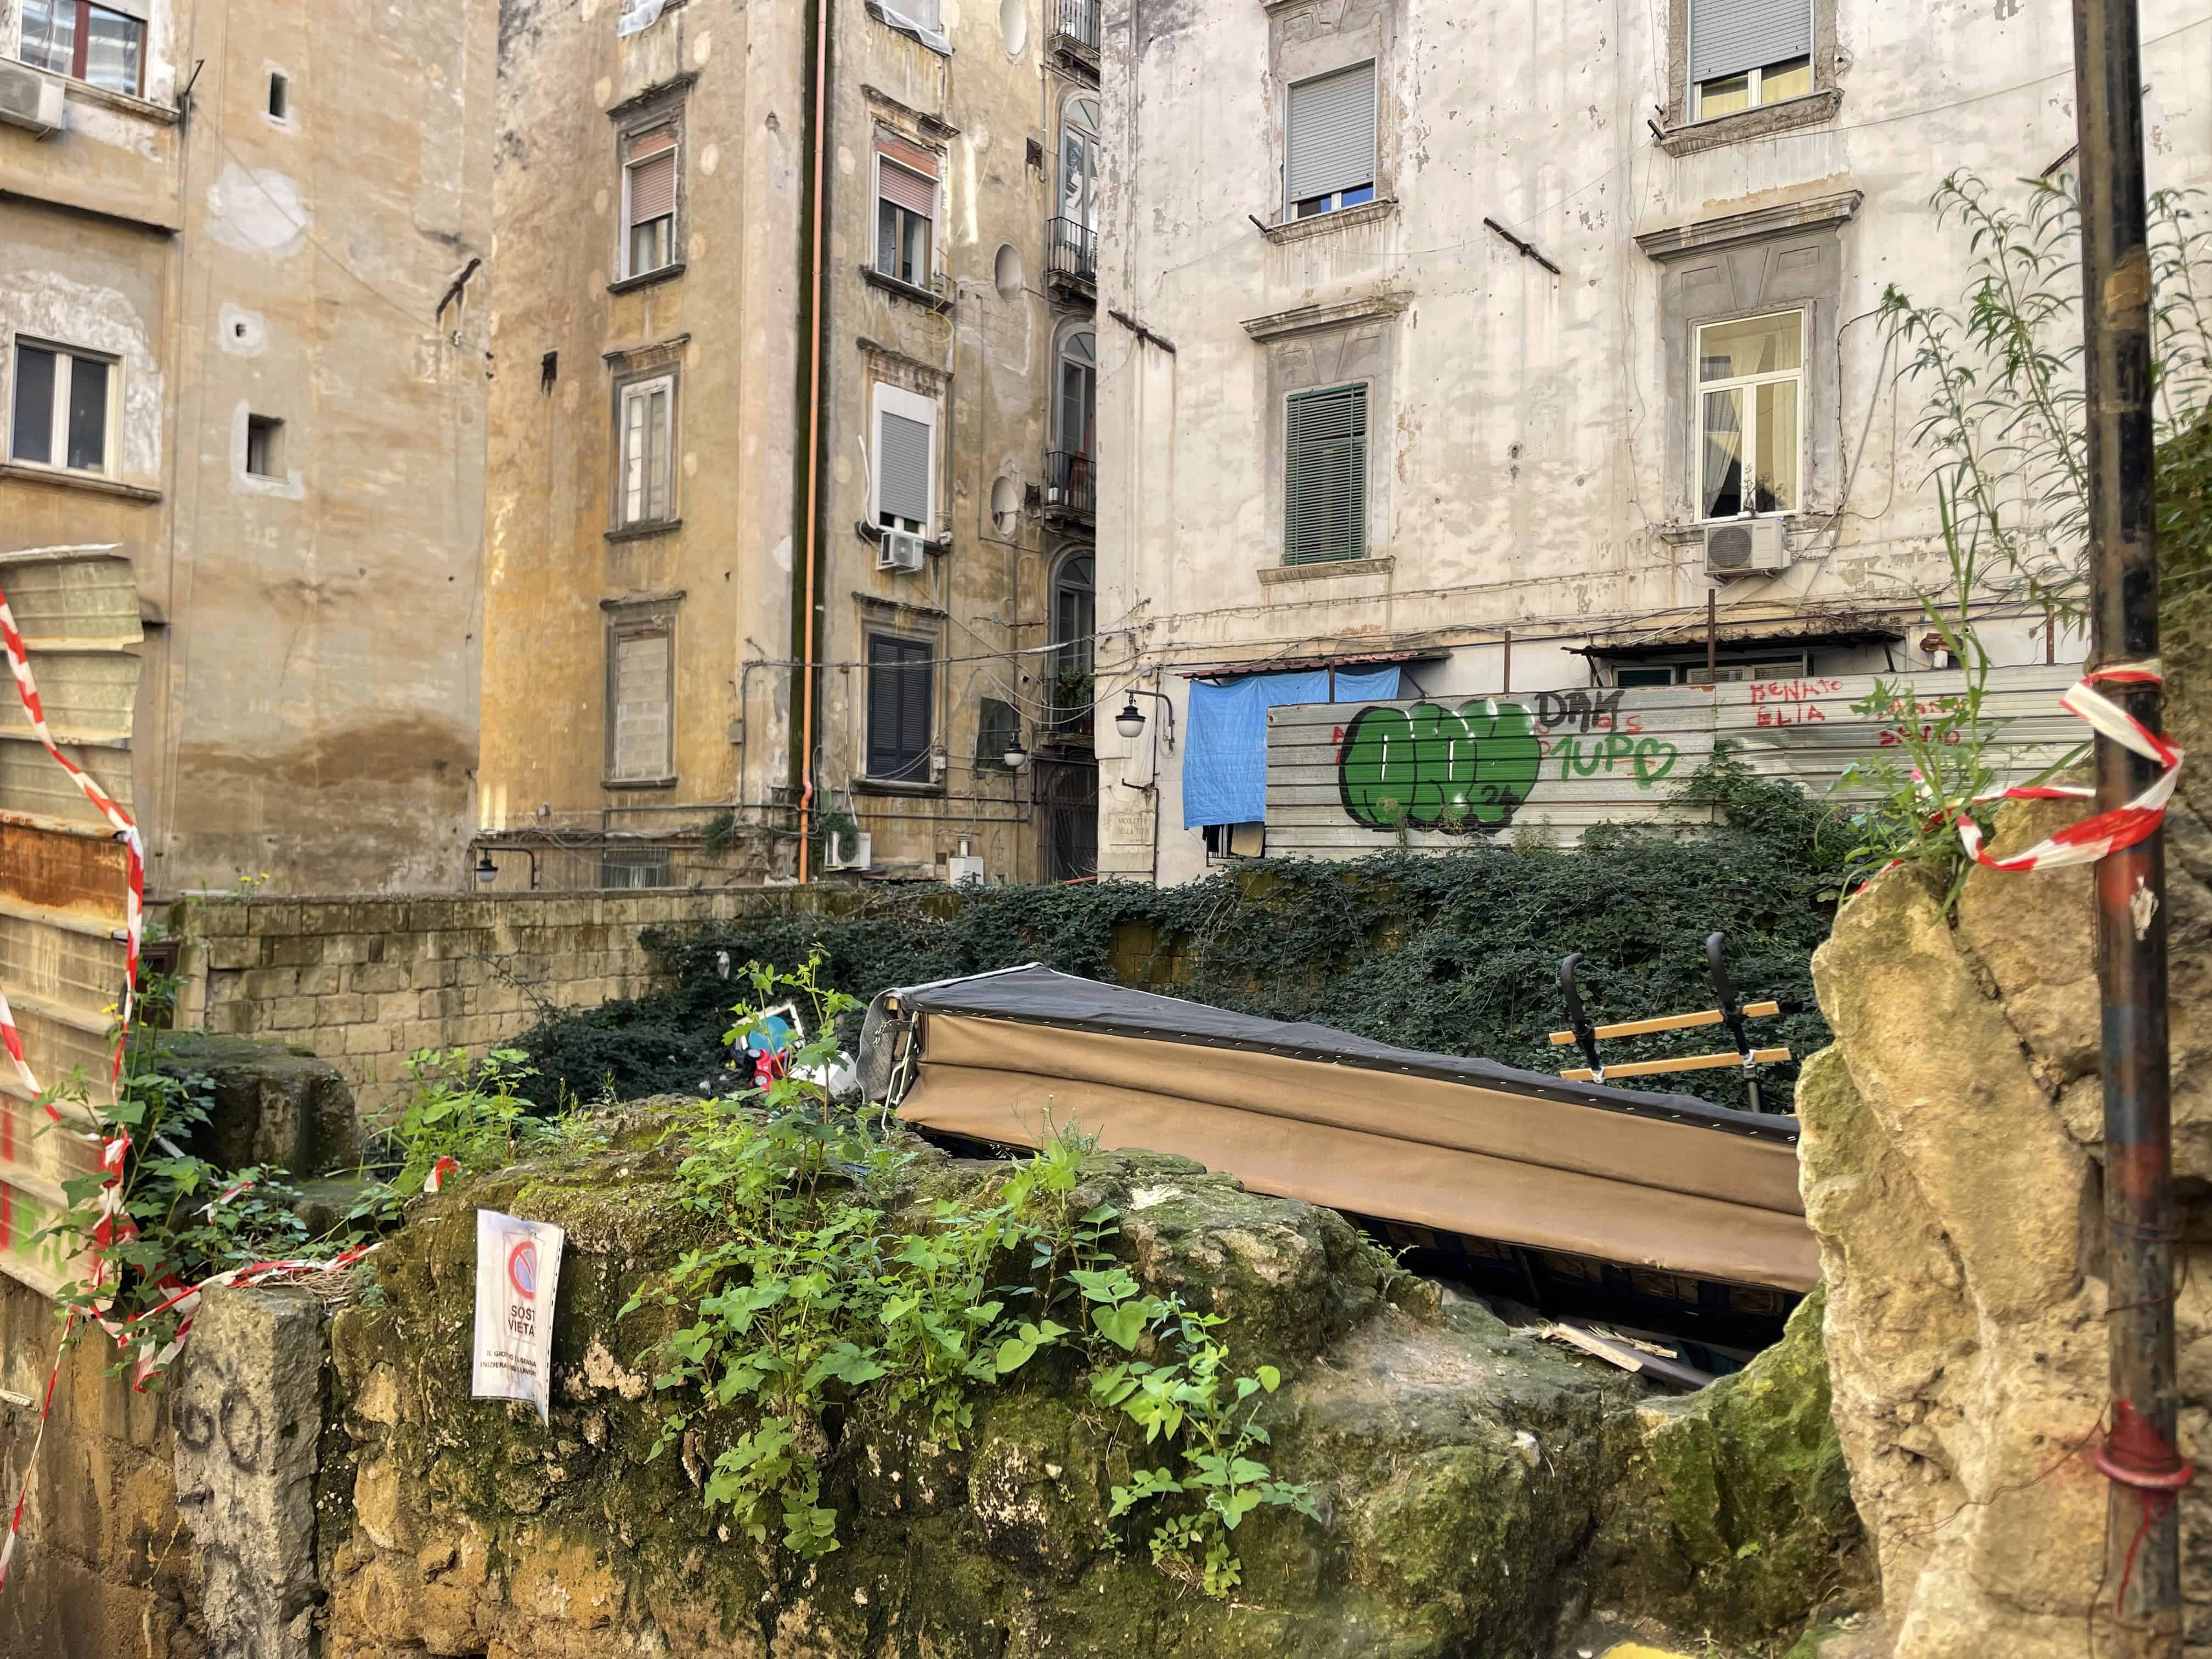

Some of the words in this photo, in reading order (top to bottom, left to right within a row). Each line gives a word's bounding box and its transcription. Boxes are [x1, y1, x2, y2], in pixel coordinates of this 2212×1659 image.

[1757, 702, 1826, 726] ELIA
[508, 1318, 536, 1338] VIETA
[494, 1351, 514, 1361] GIOO
[480, 1361, 516, 1372] INIZIERAO
